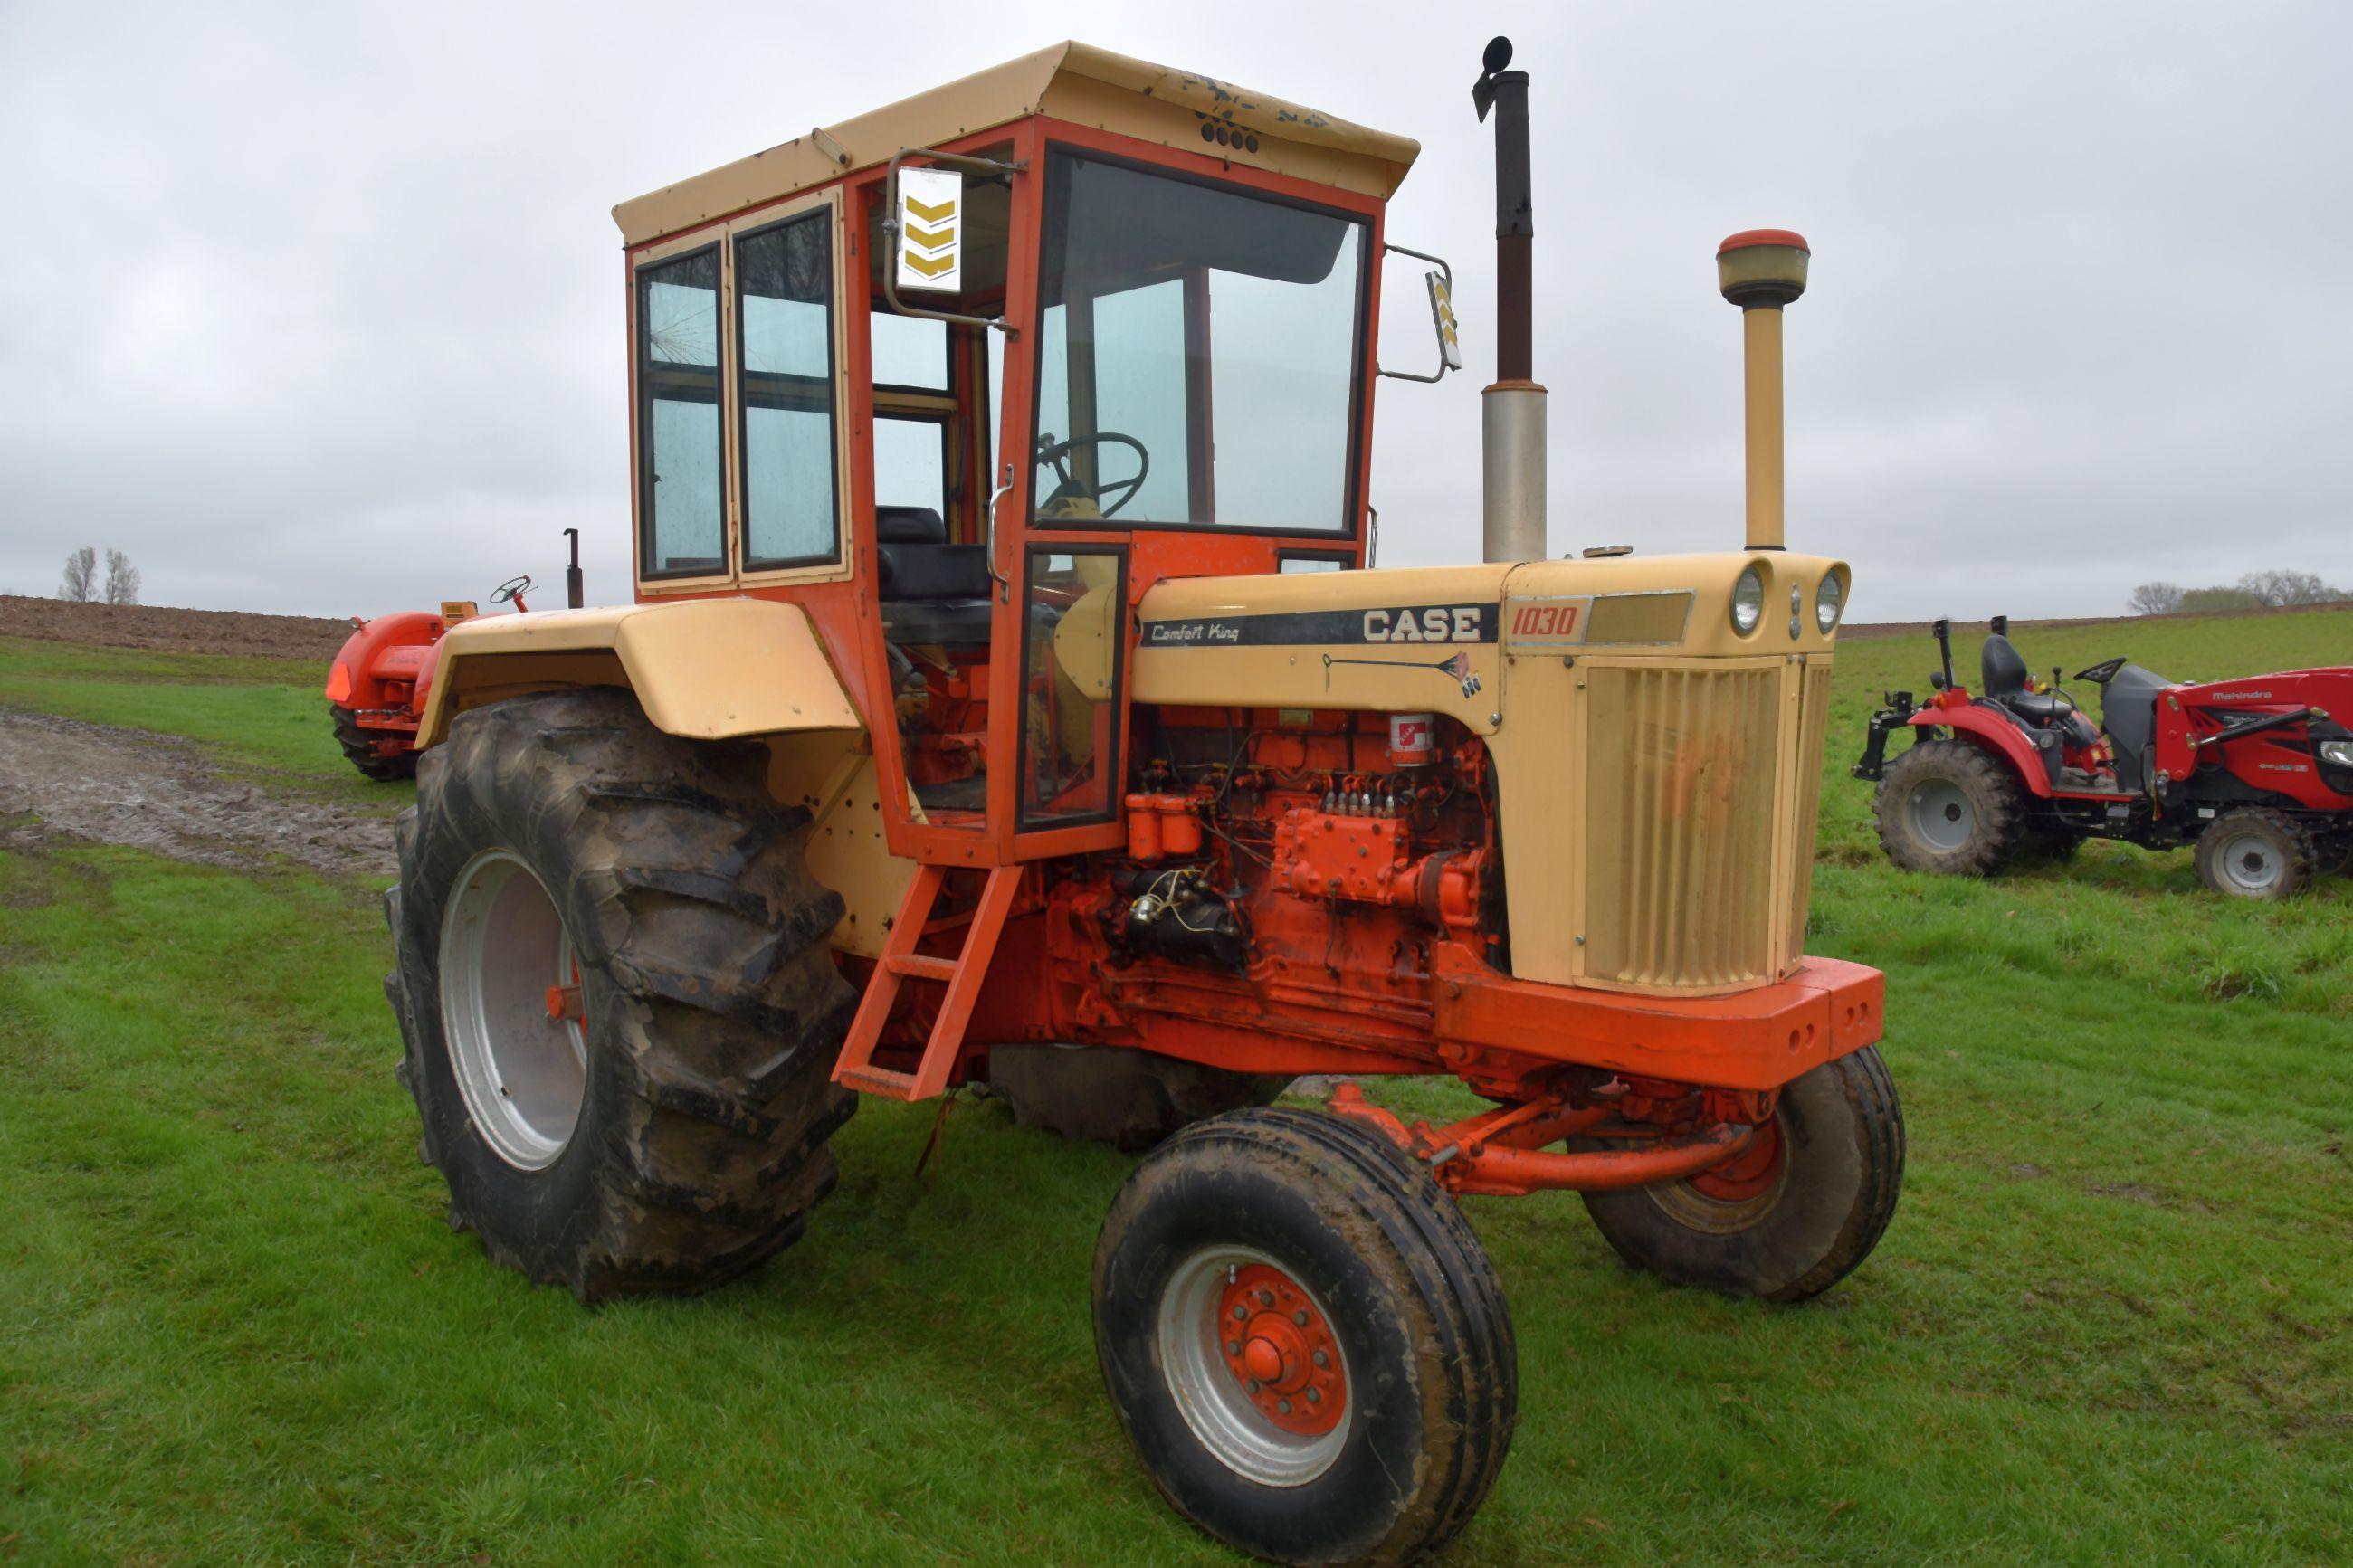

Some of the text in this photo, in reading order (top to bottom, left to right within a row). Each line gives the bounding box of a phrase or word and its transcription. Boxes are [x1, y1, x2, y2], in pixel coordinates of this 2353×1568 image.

[1152, 623, 1240, 642] Comfort King
[1363, 607, 1481, 642] CASE
[1511, 607, 1577, 635] 1030
[2212, 690, 2272, 701] Mahindra
